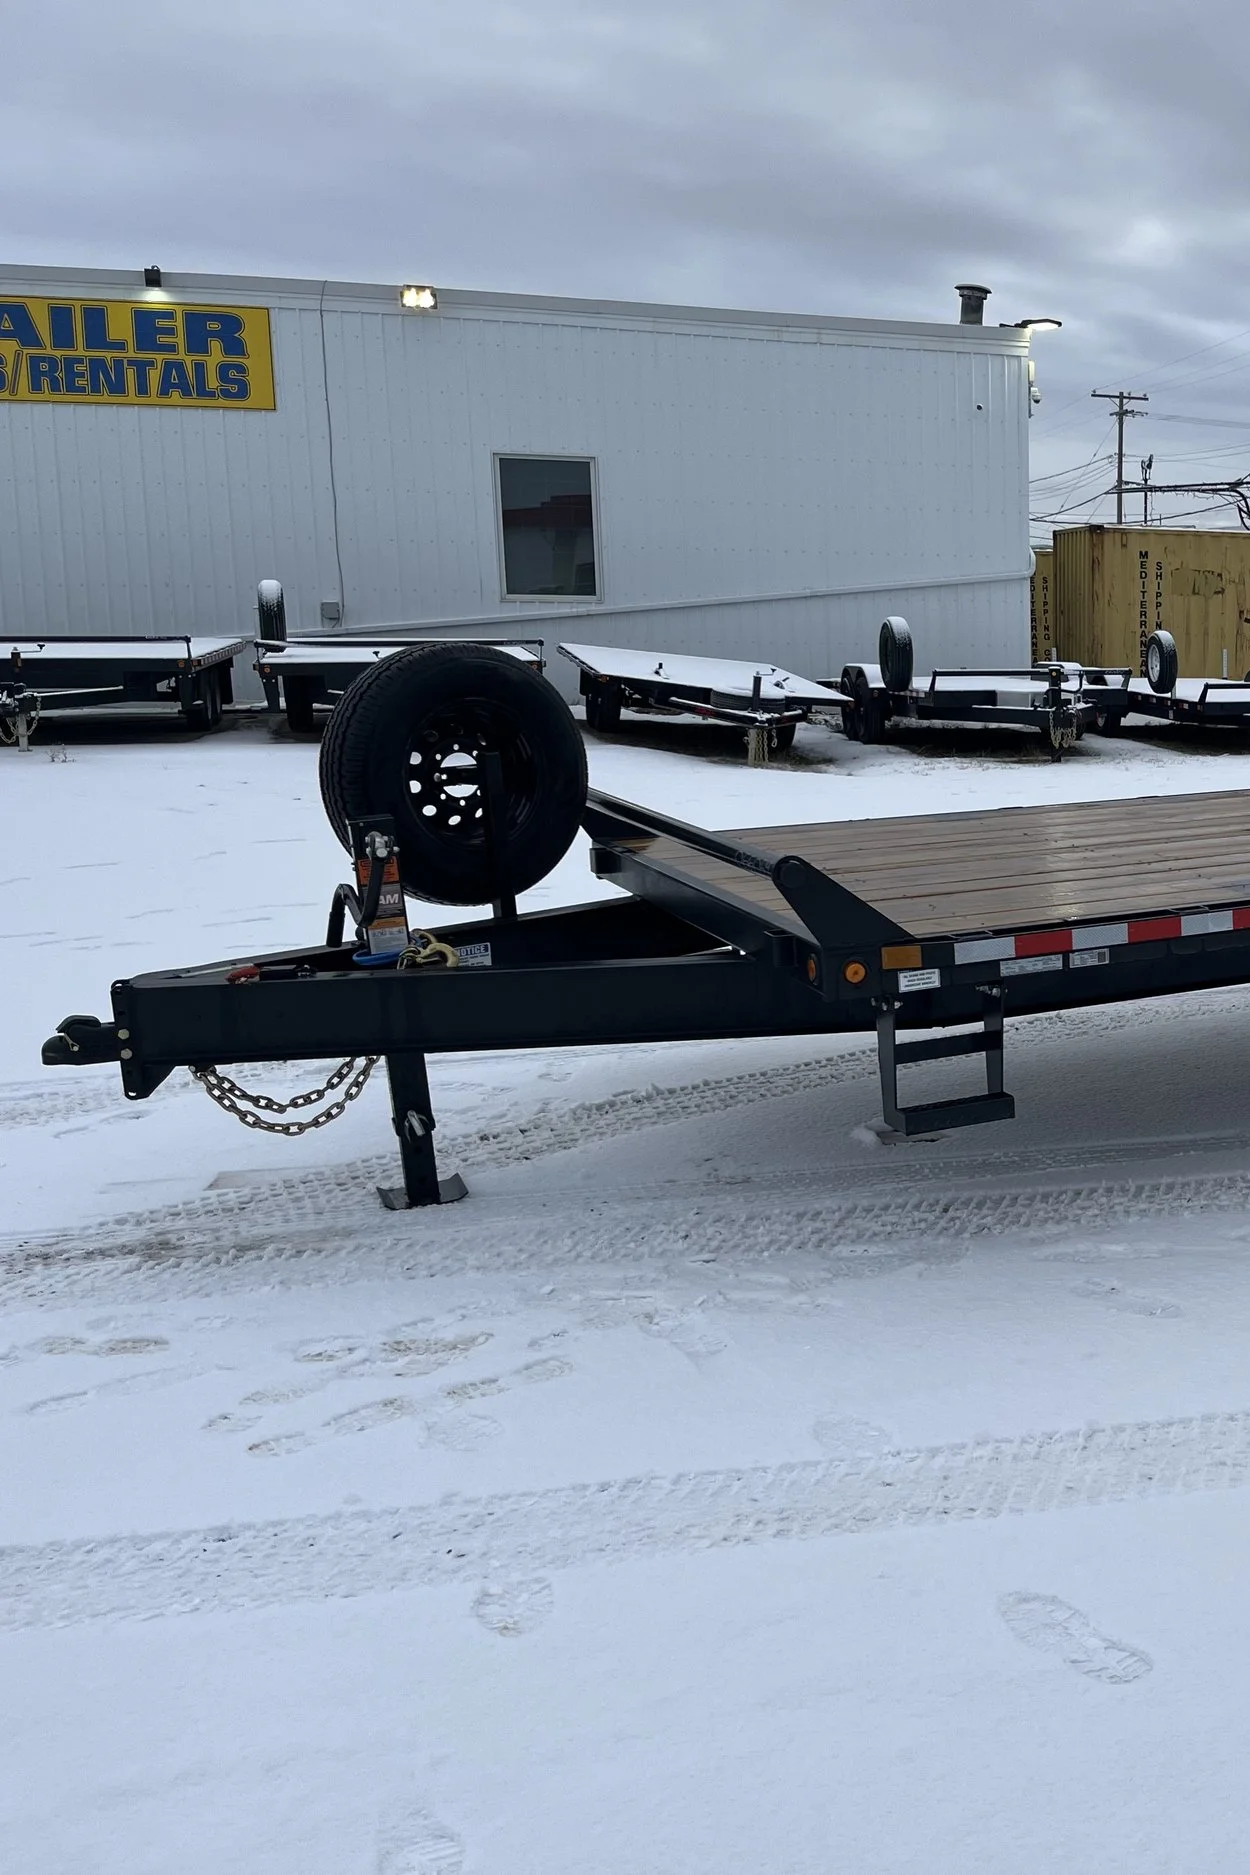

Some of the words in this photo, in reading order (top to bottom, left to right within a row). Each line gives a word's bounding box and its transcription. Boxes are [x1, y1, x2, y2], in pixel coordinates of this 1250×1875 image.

[0, 350, 250, 401] /RENTALS
[1042, 577, 1050, 640] SHIPPING
[1139, 551, 1149, 678] MEDITERRANEAN
[1155, 561, 1163, 630] SHIPPIN
[379, 893, 399, 905] AM
